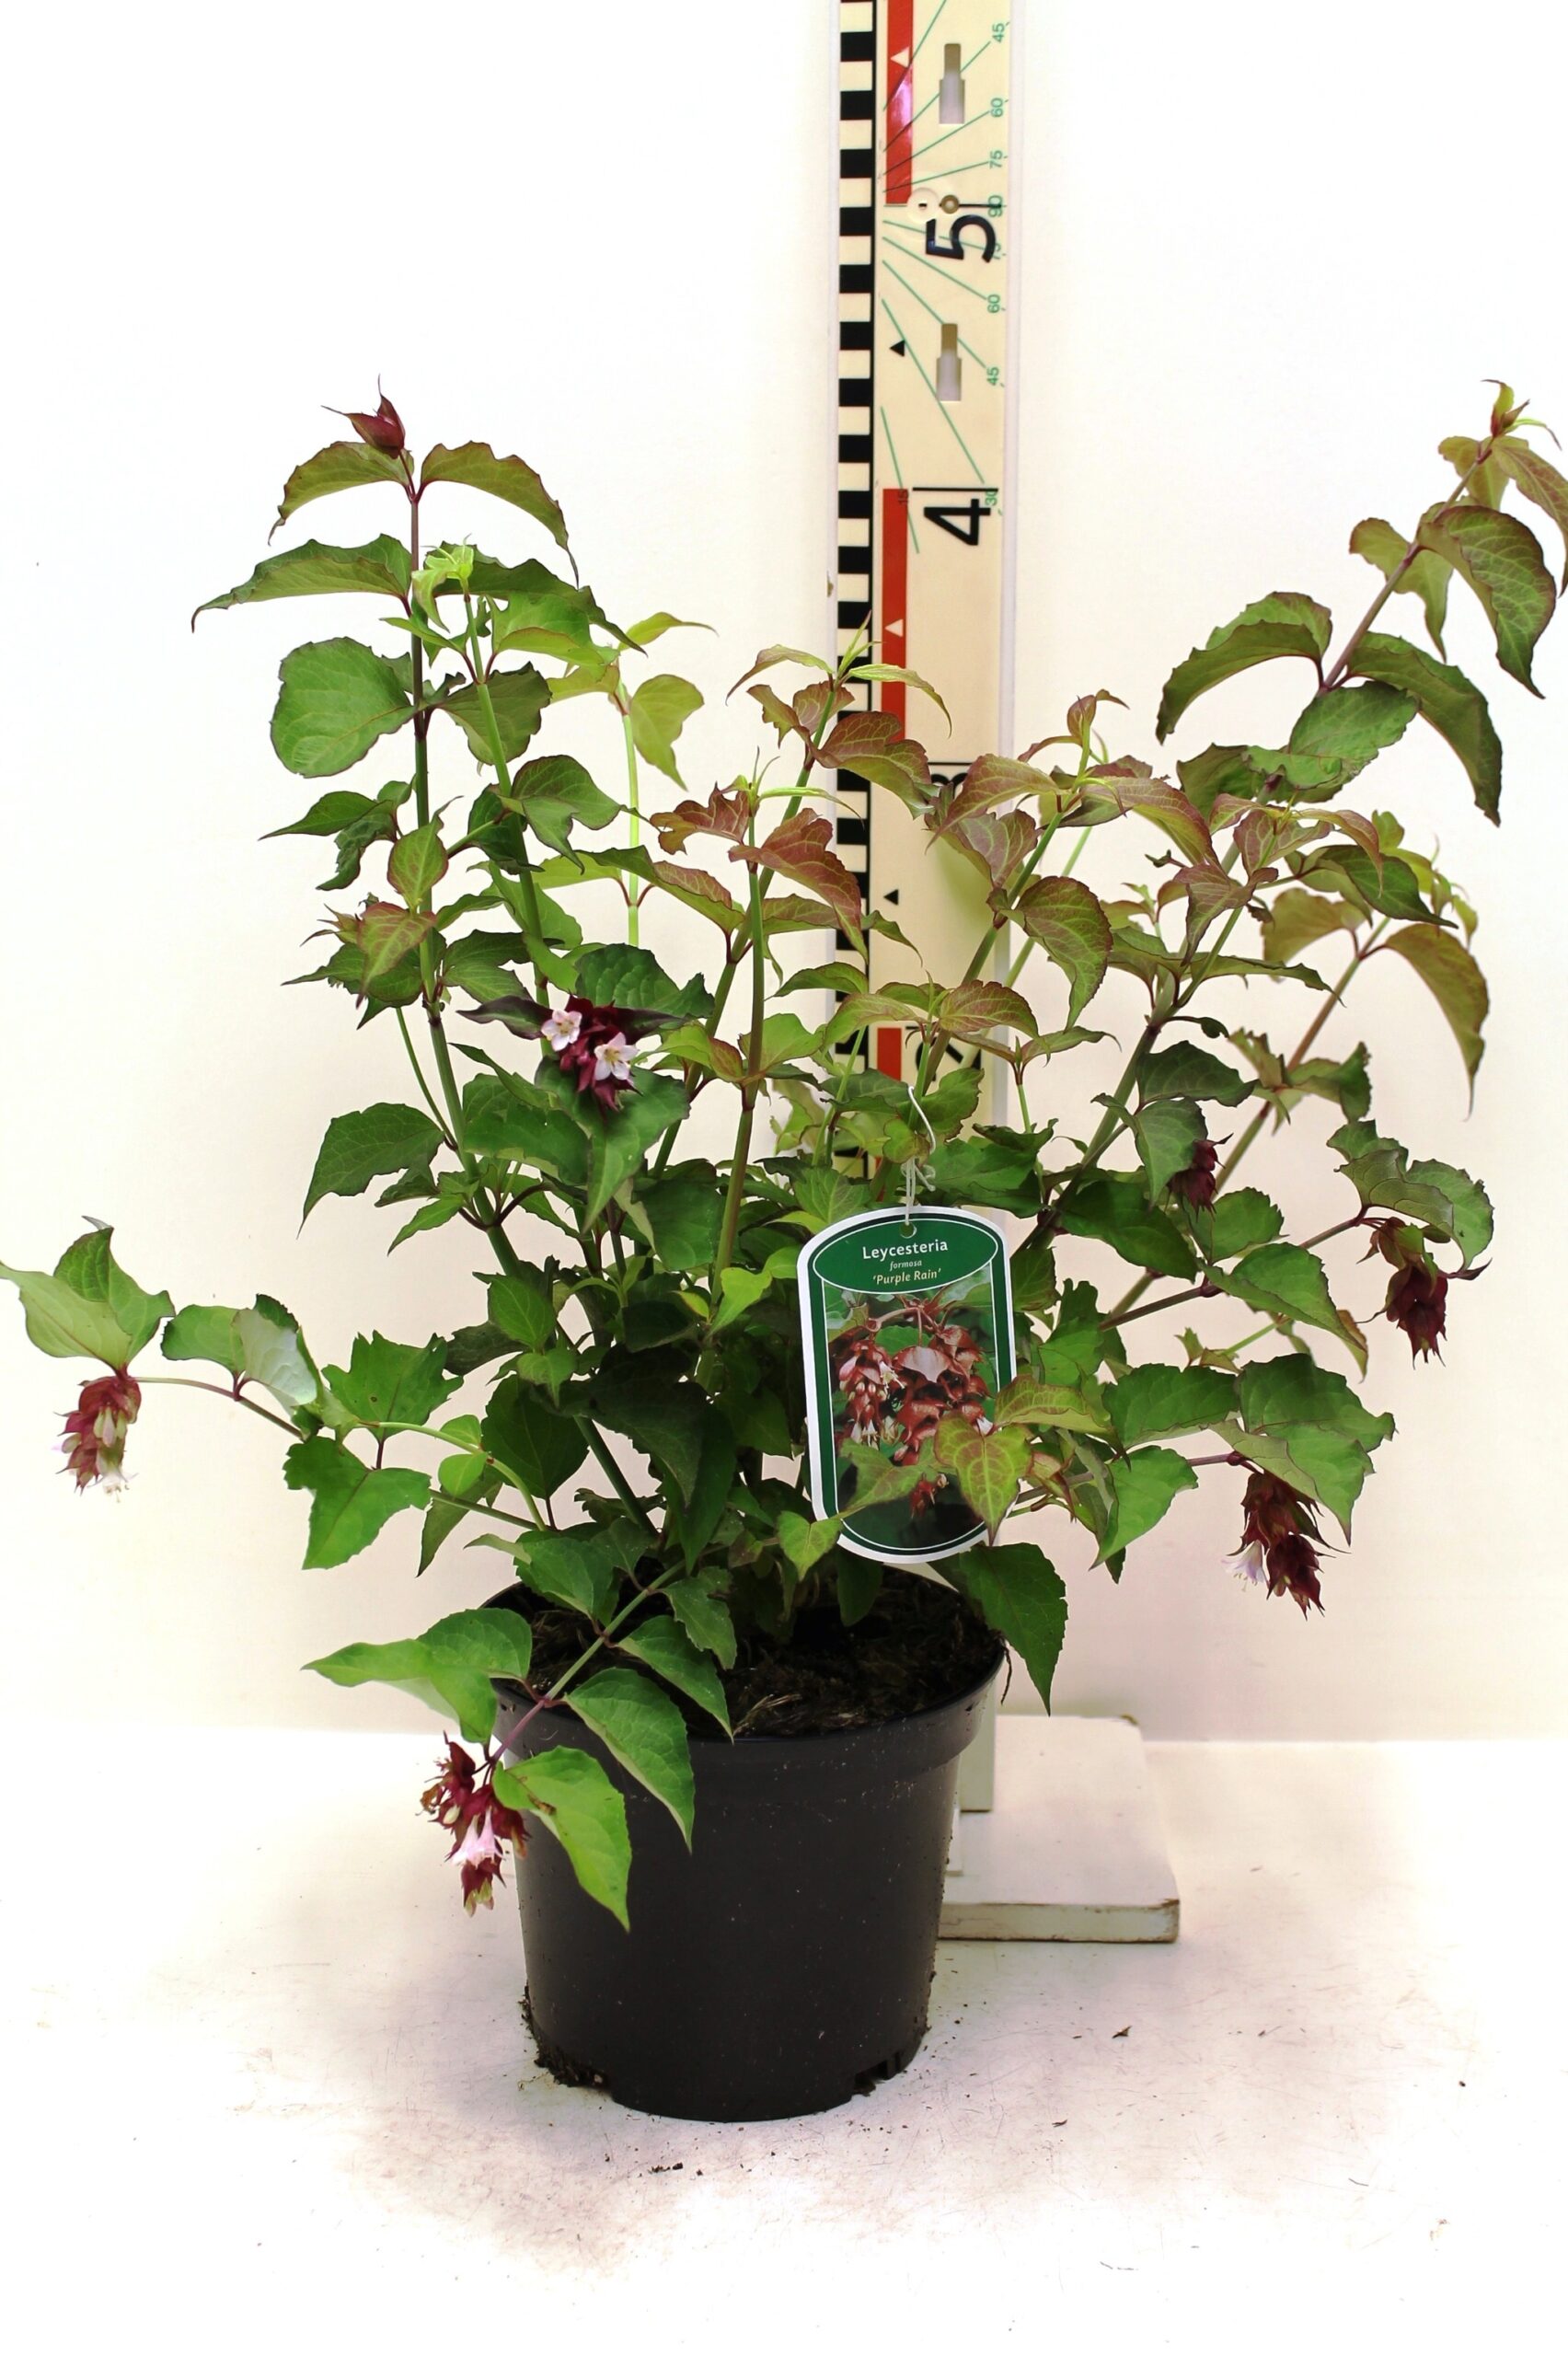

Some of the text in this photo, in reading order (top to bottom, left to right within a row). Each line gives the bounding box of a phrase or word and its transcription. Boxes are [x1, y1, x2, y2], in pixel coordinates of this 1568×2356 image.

[992, 22, 1006, 43] 45
[990, 97, 1004, 118] 60
[989, 149, 1003, 168] 75
[925, 214, 997, 263] 5
[986, 294, 1001, 314] 60
[986, 366, 1000, 386] 45
[923, 498, 991, 546] 4
[862, 1239, 949, 1262] Leycesteria
[889, 1259, 923, 1272] formosa
